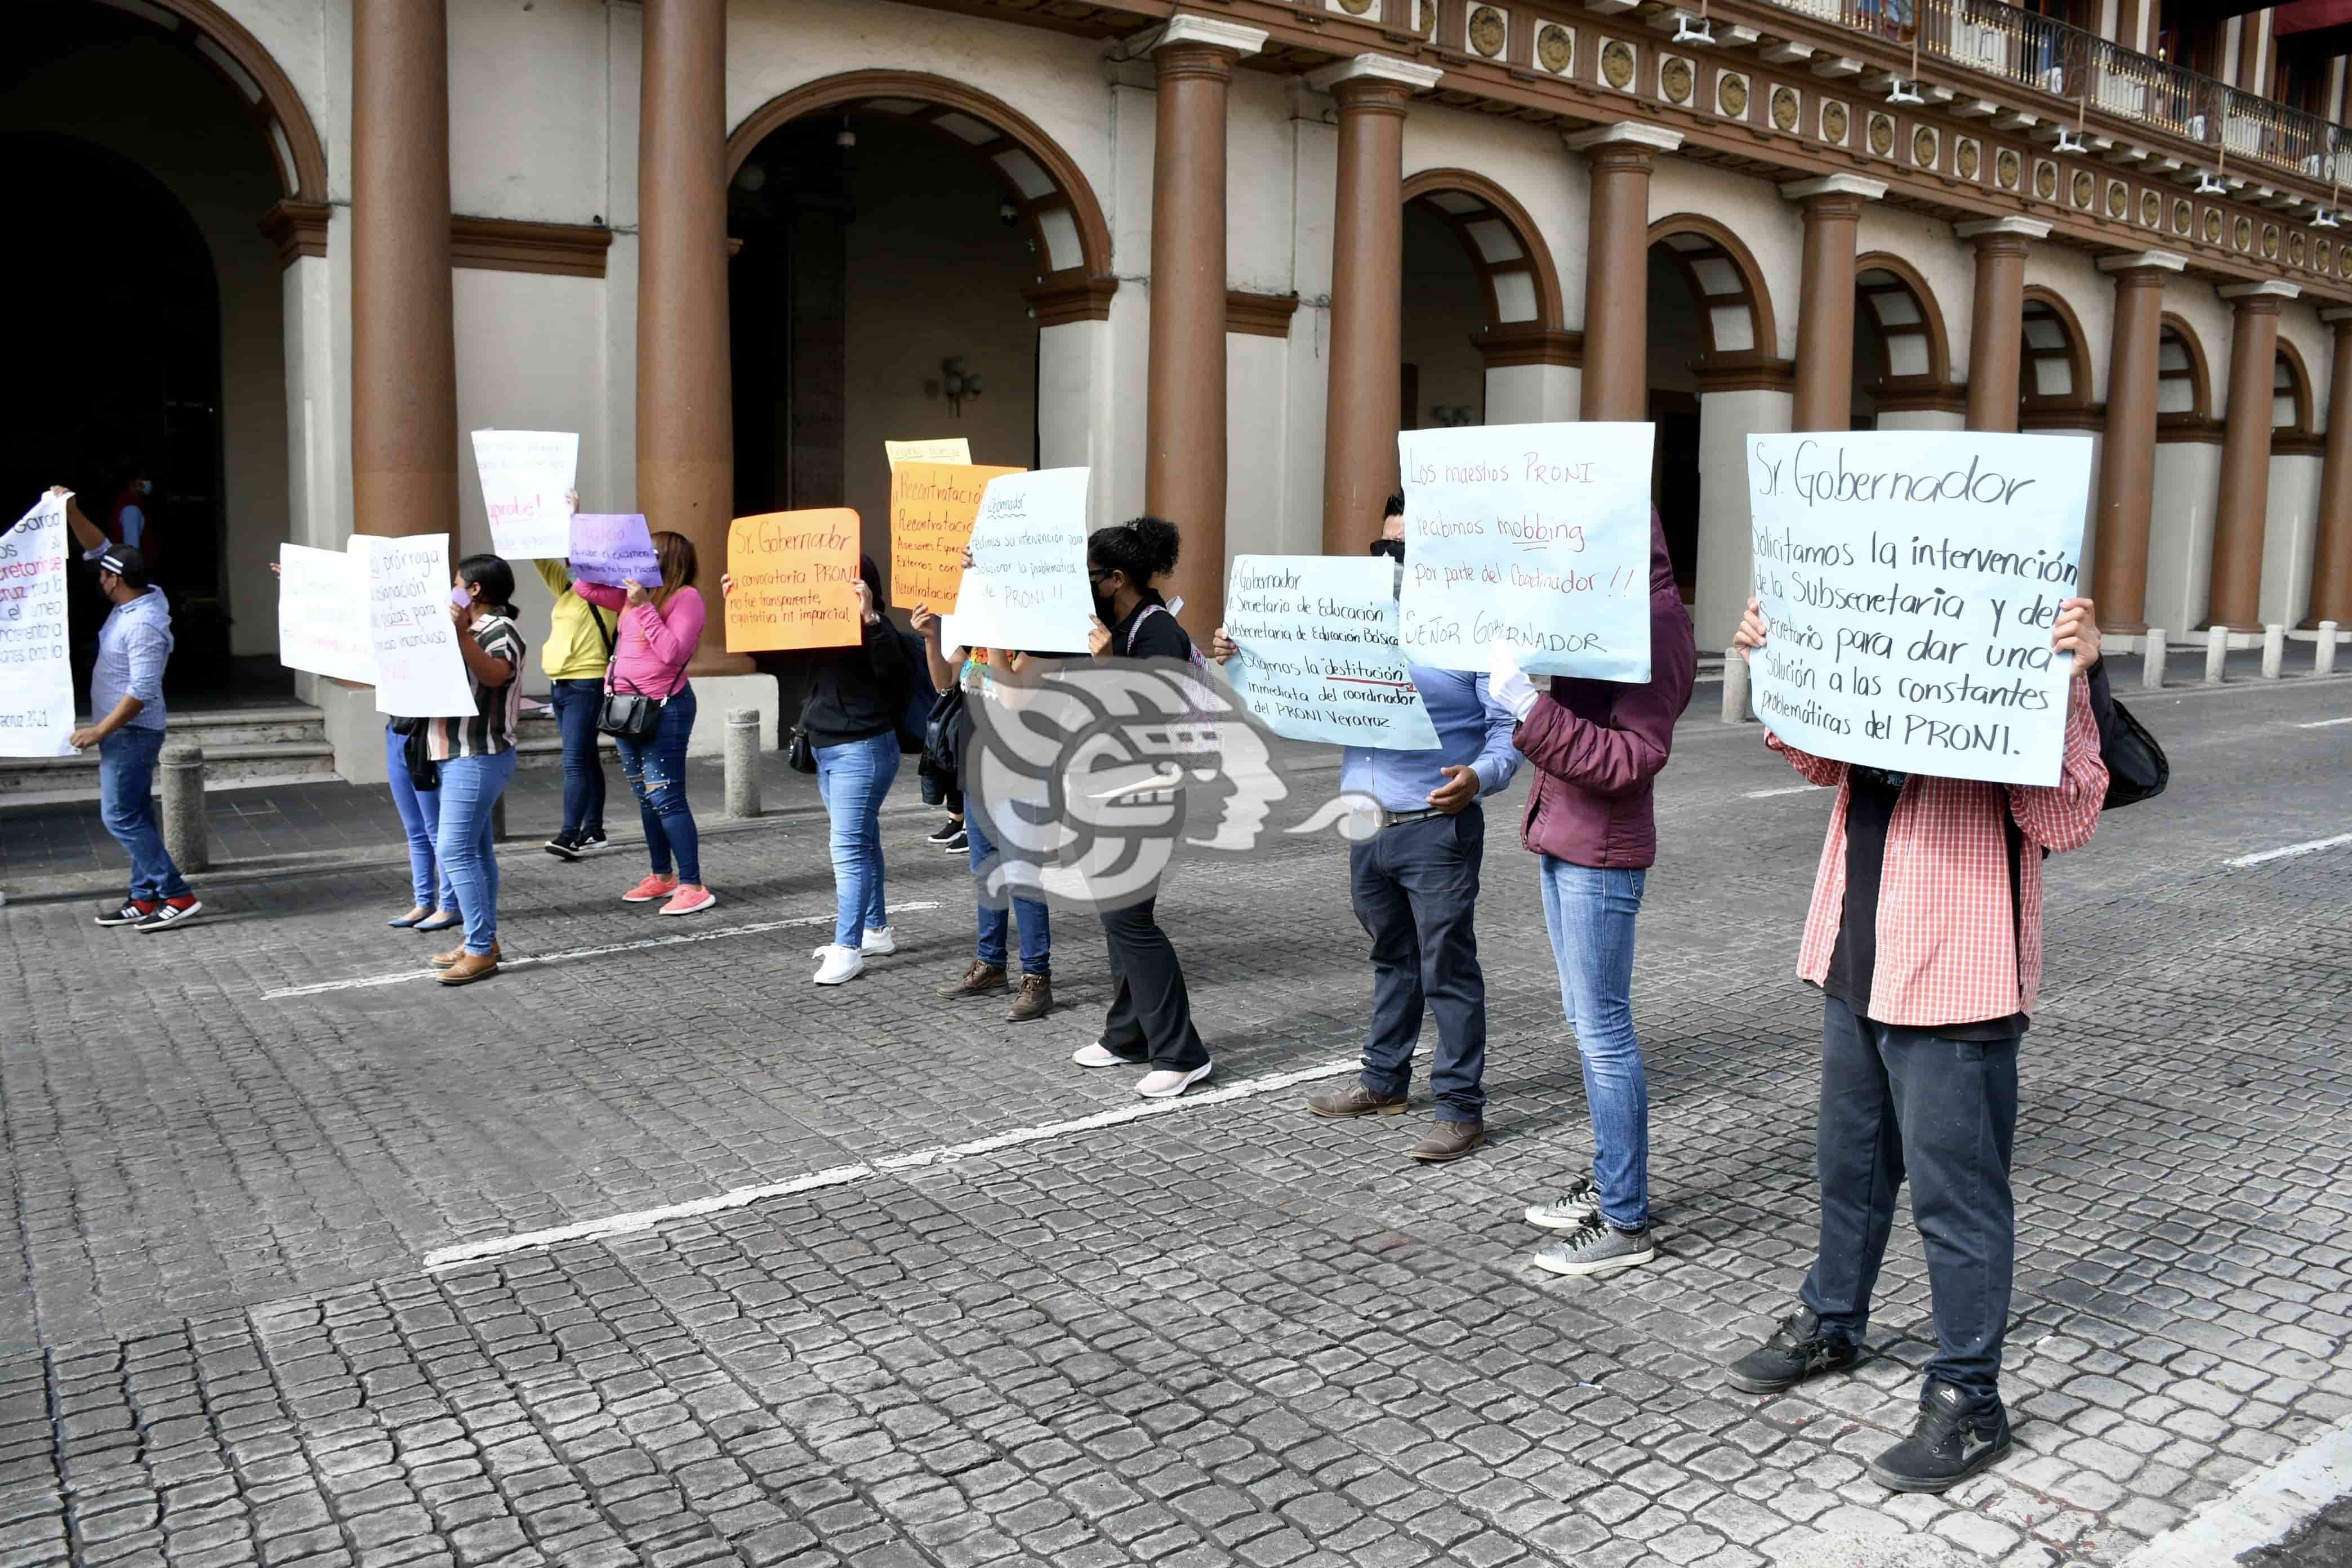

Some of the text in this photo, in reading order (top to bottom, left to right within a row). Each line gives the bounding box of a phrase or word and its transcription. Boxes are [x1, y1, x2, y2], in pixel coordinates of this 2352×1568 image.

[1410, 447, 1436, 484] Los
[1523, 451, 1596, 485] PRONI
[1756, 440, 2037, 507] Sr. Gobernador
[901, 471, 983, 508] Recontratació
[898, 509, 974, 535] Recontratació
[1416, 510, 1586, 553] recibimos mobbing
[758, 520, 852, 554] Gobernador
[897, 535, 934, 551] Asesores
[1004, 535, 1015, 547] su
[1752, 515, 2078, 586] Solicitamos la intervención
[612, 549, 650, 560] examen
[896, 555, 958, 573] Externos con
[742, 567, 807, 586] convocatoria
[1239, 560, 1302, 591] Gobernador
[1444, 562, 1475, 589] parte
[1481, 562, 1502, 583] del
[730, 598, 742, 609] no
[743, 591, 758, 608] fue
[1004, 586, 1045, 609] PRONI
[1237, 593, 1290, 614] Secretario
[1297, 596, 1312, 614] de
[1318, 598, 1384, 622] Educación
[1756, 564, 1769, 593] de
[1770, 571, 1784, 600] la
[2018, 594, 2064, 630] del
[8, 604, 21, 621] el
[730, 610, 777, 629] equitativa
[782, 610, 794, 623] ni
[1296, 625, 1307, 641] de
[1405, 610, 1608, 653] SEÑOR GOBRNADOR
[1758, 600, 2053, 673] Secretario para dar una
[1240, 652, 1302, 681] Exigimos
[1304, 655, 1318, 675] la
[1248, 678, 1416, 705] inmediata del coordinador
[1828, 674, 1843, 693] a
[1852, 666, 1882, 696] las
[1898, 673, 2050, 710] constantes
[1254, 702, 1269, 715] del
[1277, 704, 1322, 723] PRONI
[1760, 689, 1852, 735] problemáticas
[1865, 709, 1892, 740] del
